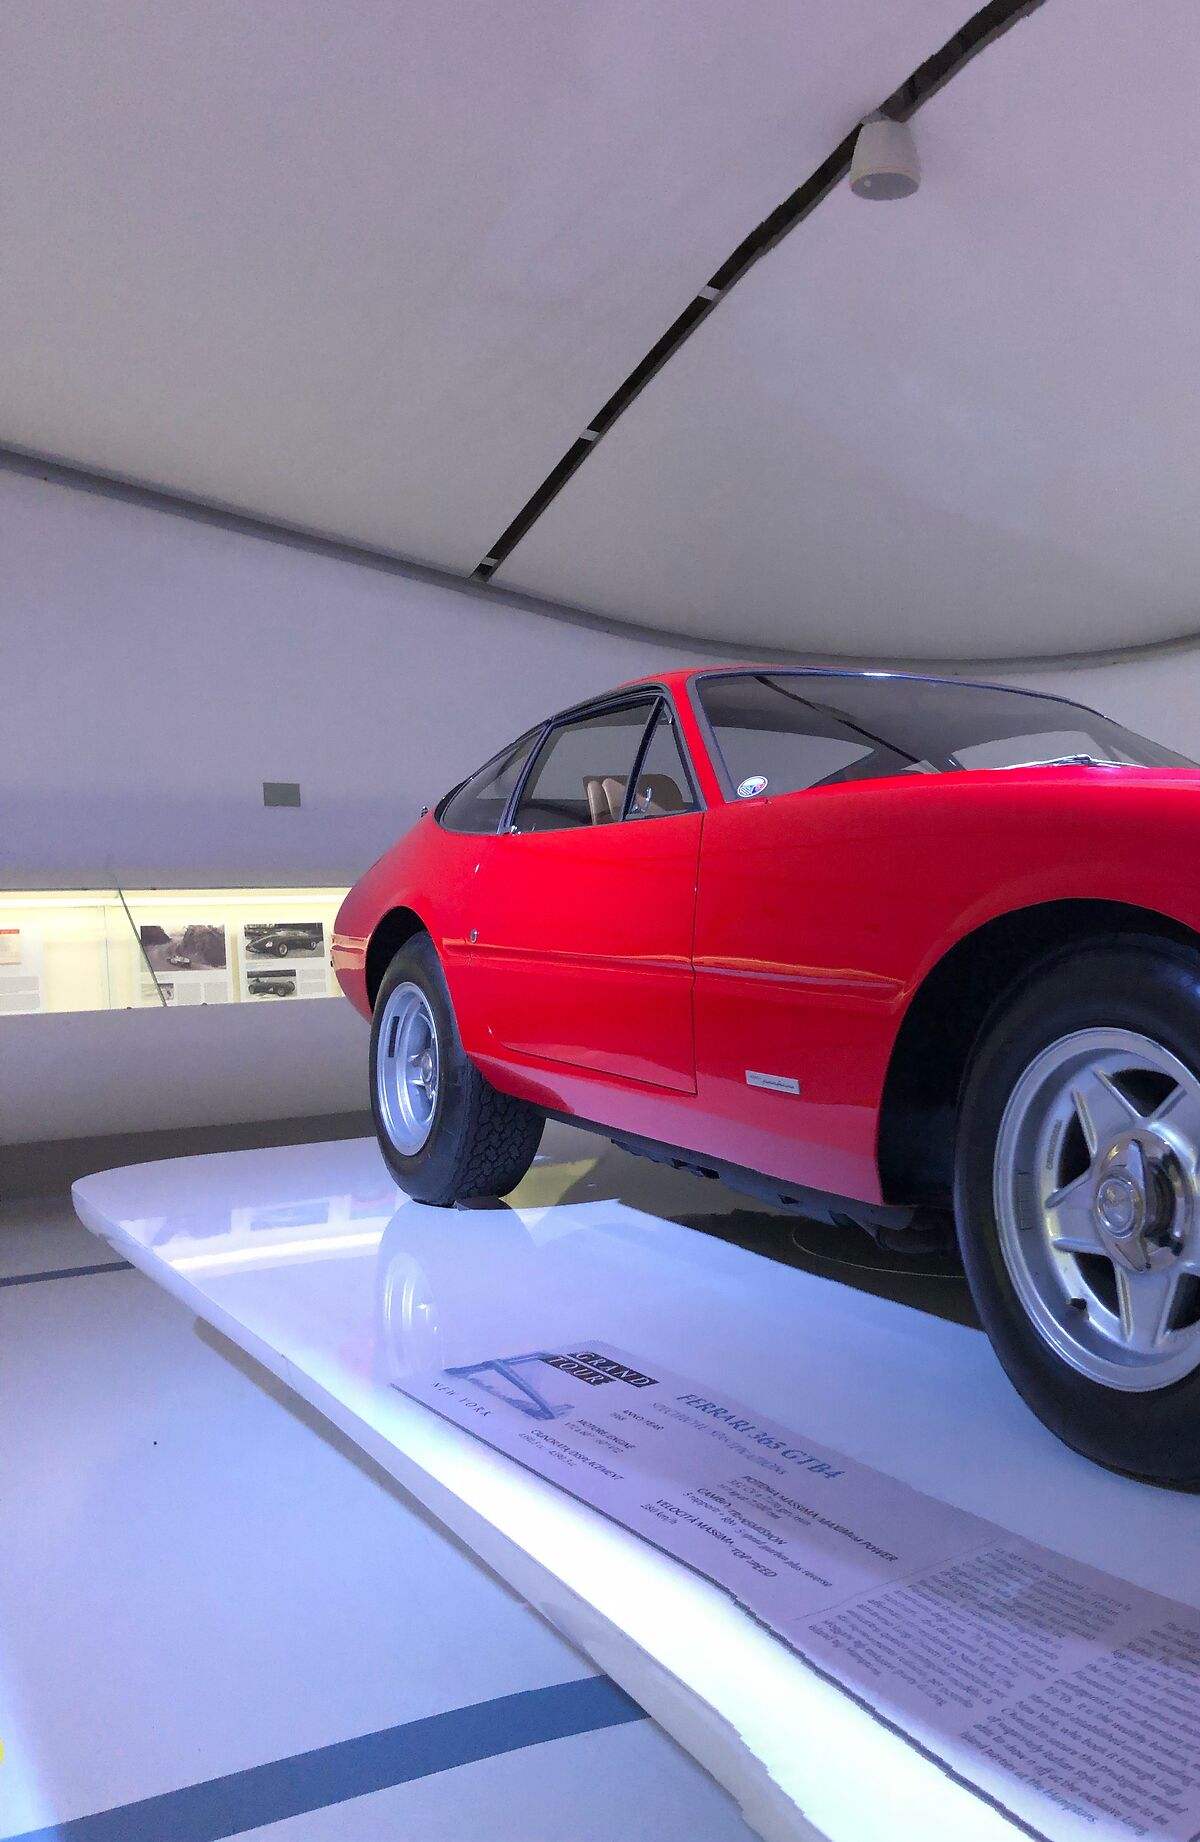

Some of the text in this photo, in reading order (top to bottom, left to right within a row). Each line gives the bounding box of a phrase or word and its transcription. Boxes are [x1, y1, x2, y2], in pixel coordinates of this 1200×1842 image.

[549, 1356, 606, 1383] TOUR
[575, 1352, 650, 1386] GRAND
[432, 1381, 494, 1417] NEW YORK
[676, 1394, 845, 1479] FERRARI 365 GTB4
[656, 1499, 700, 1524] VELOCITÀ
[860, 1540, 898, 1562] POWER
